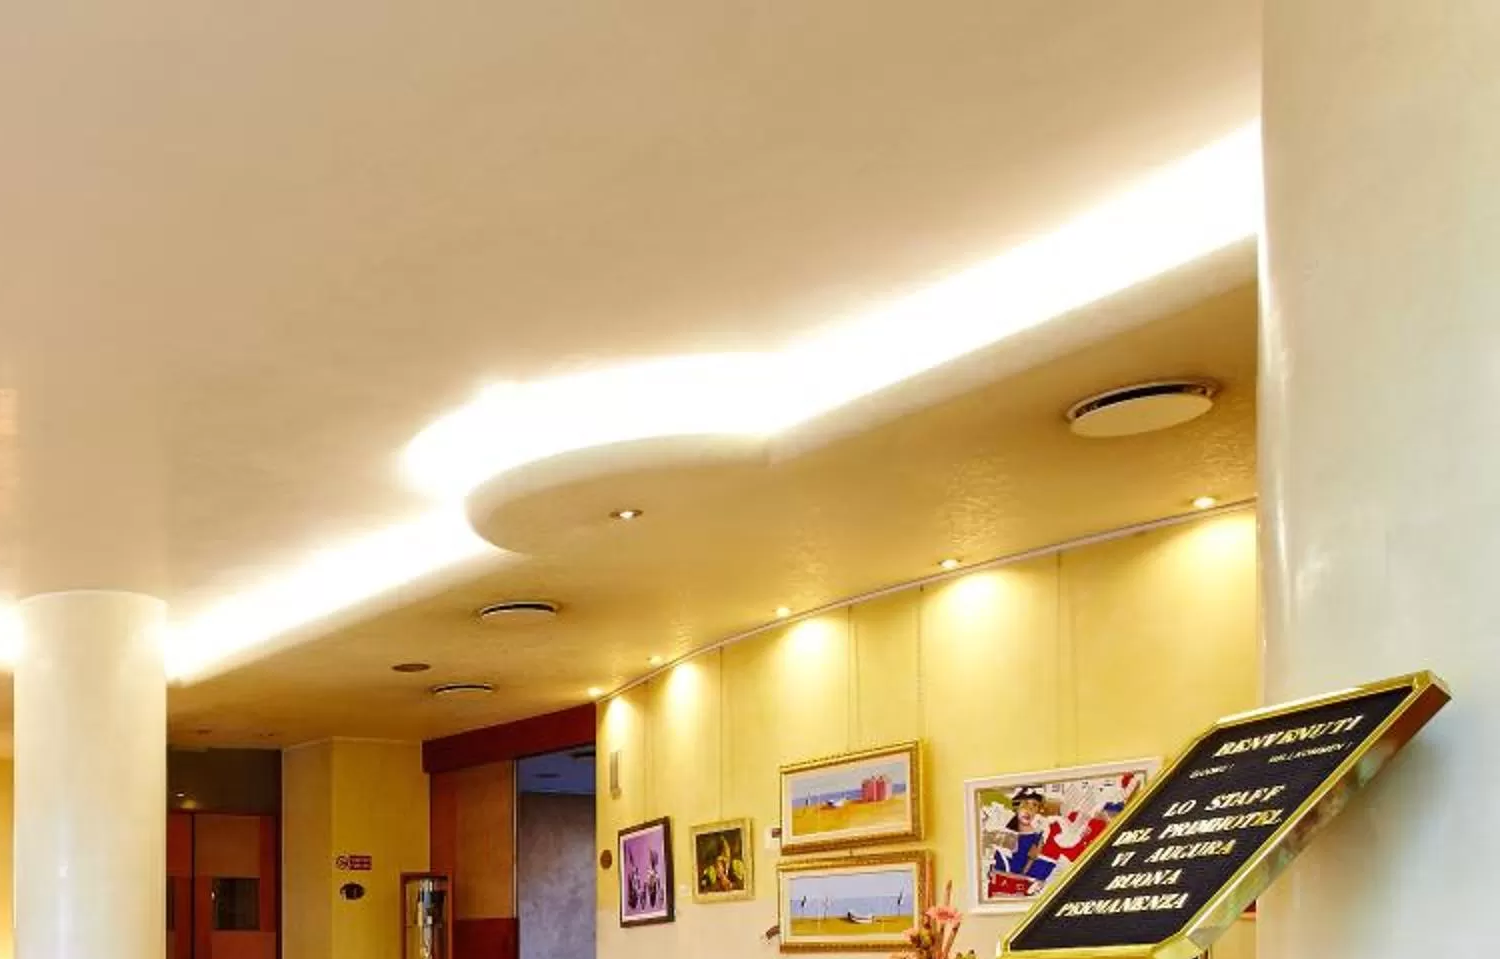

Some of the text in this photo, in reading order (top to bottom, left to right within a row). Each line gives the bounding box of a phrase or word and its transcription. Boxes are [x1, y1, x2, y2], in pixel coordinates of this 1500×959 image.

[1212, 714, 1365, 758] BENVENUTI
[1161, 785, 1287, 818] LO STAFF
[1112, 827, 1153, 847] DEL
[1111, 839, 1236, 868] VI AUGURA
[1104, 868, 1182, 891] BUONA
[1055, 893, 1189, 917] PERMANENZA
